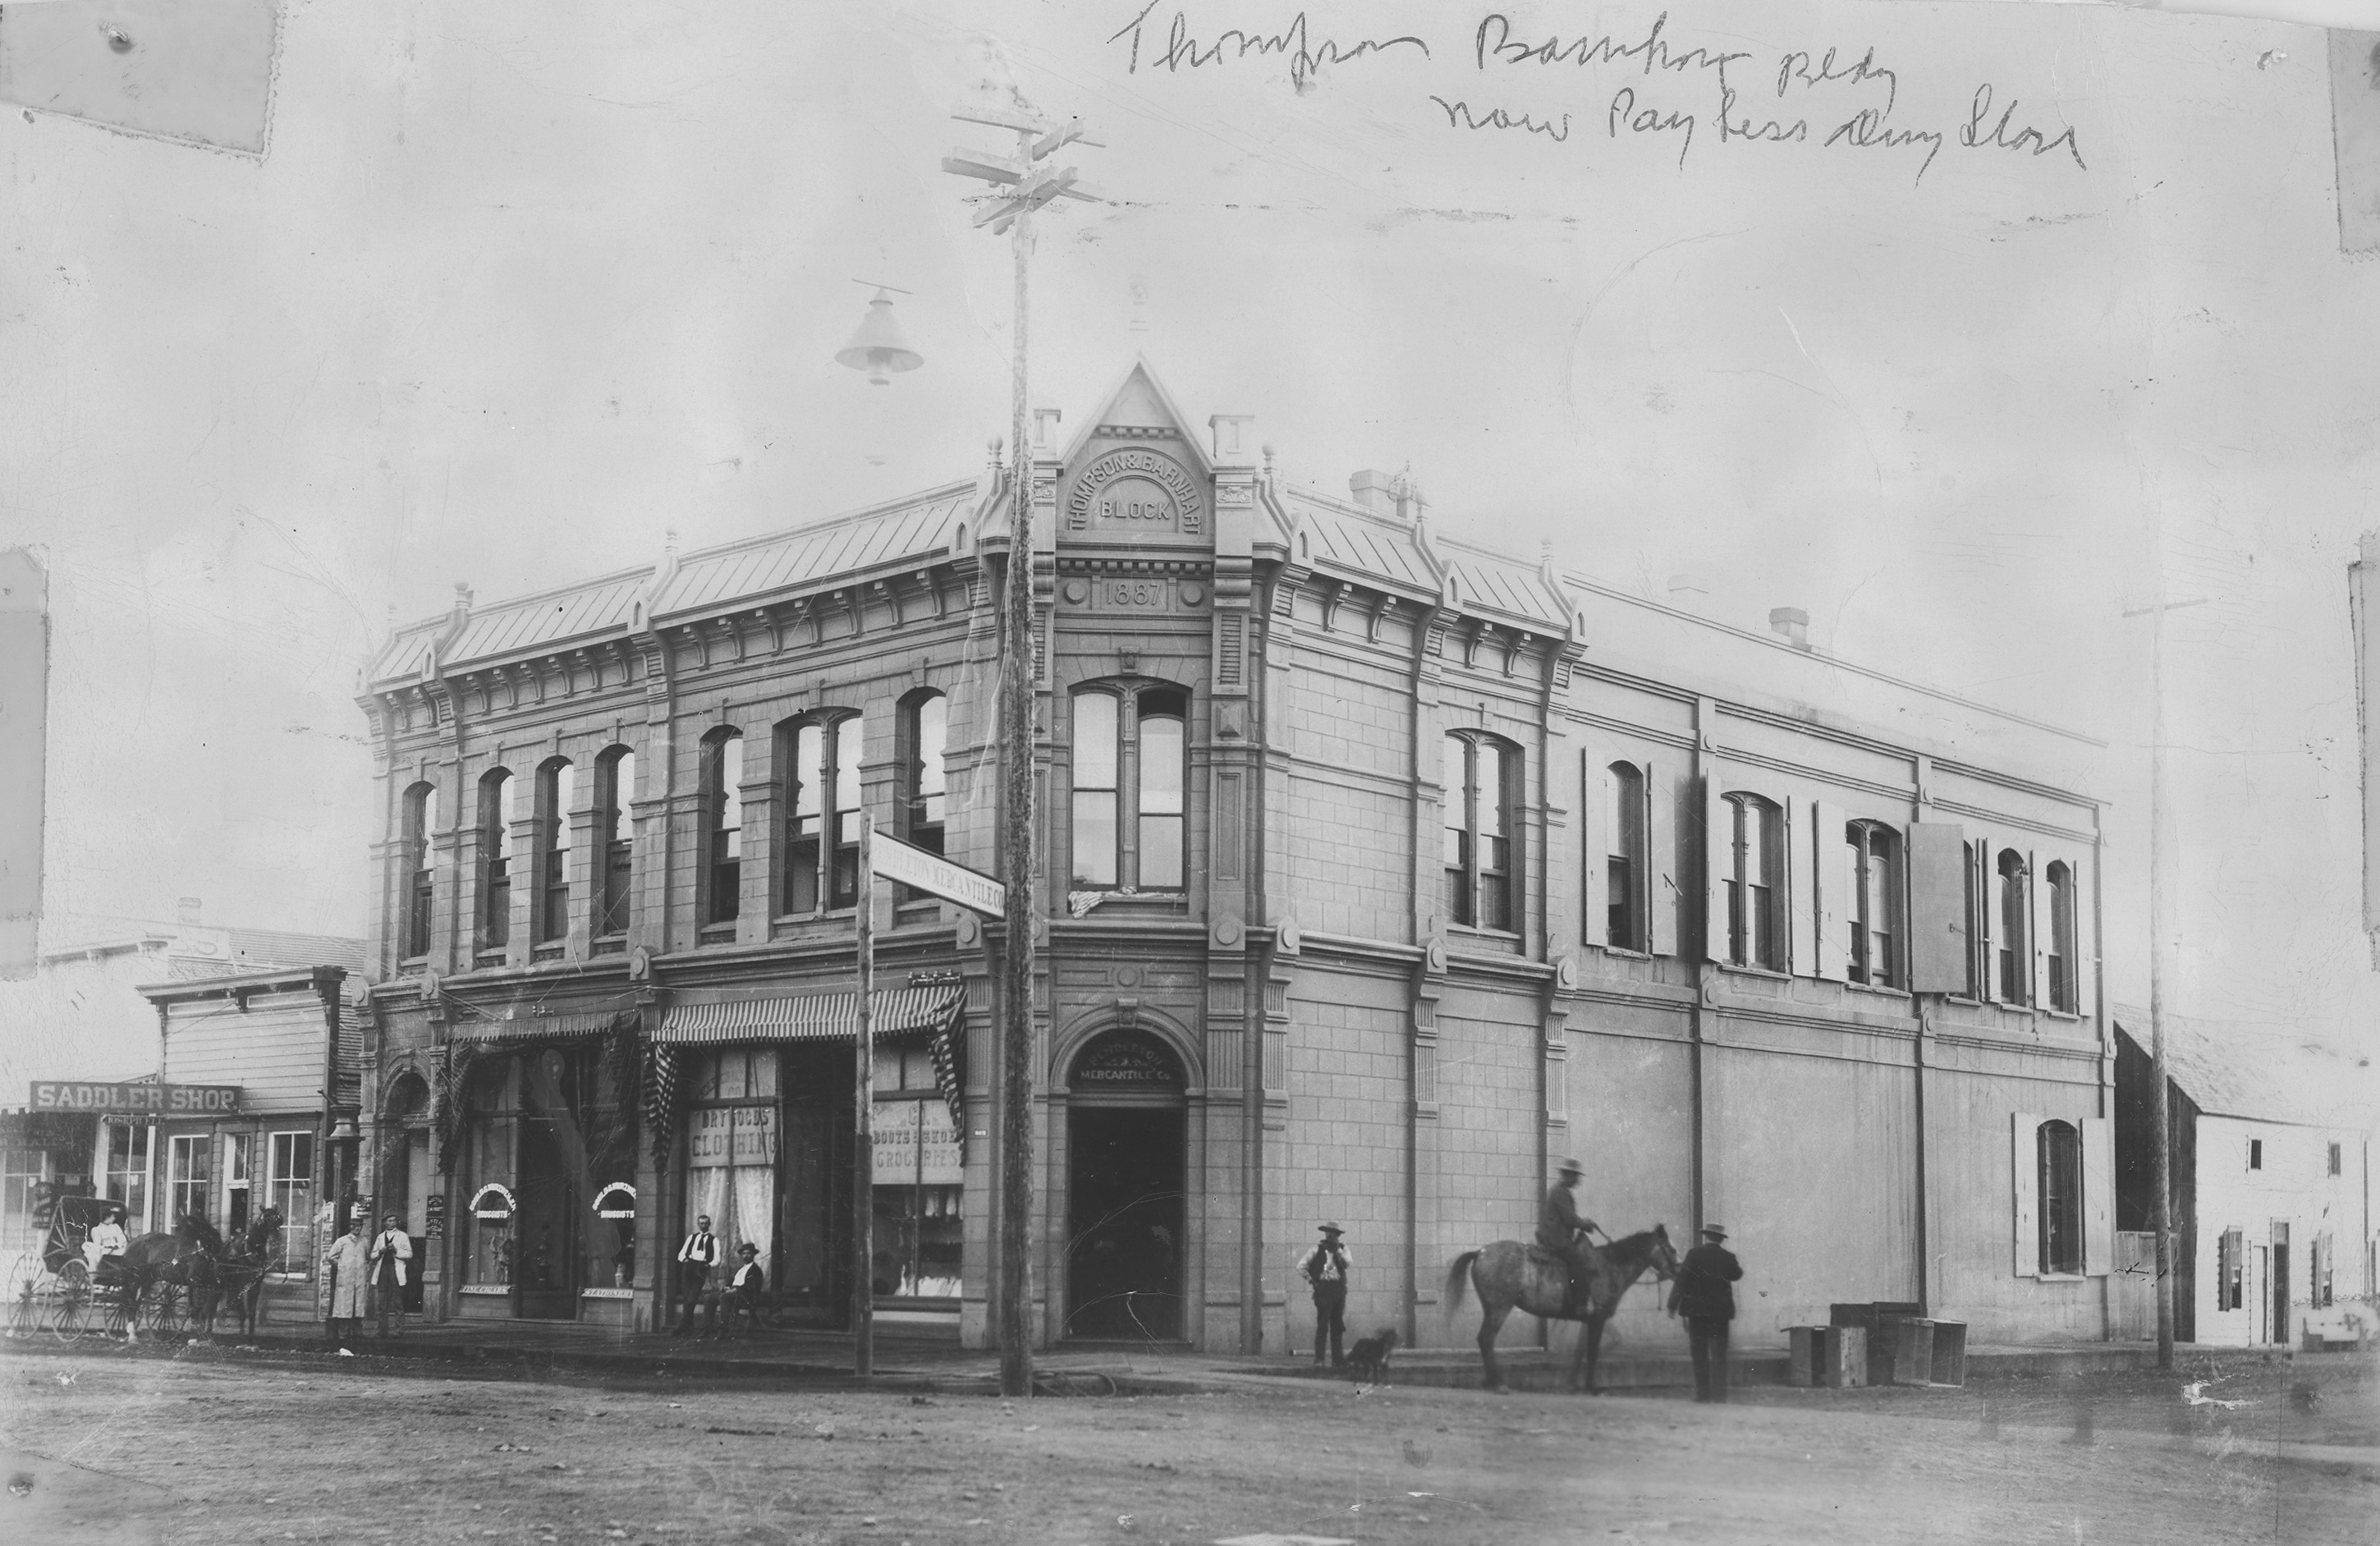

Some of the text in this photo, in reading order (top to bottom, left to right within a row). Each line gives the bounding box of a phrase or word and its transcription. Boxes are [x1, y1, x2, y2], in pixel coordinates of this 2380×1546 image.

[1100, 499, 1172, 520] BLOCK
[1107, 582, 1162, 606] 1887
[1080, 1070, 1152, 1080] MERCANTILE
[37, 1084, 163, 1109] SADDLER
[702, 1109, 768, 1128] DRY OODS
[873, 1130, 910, 1145] BOOTS
[922, 1130, 956, 1145] SHOE
